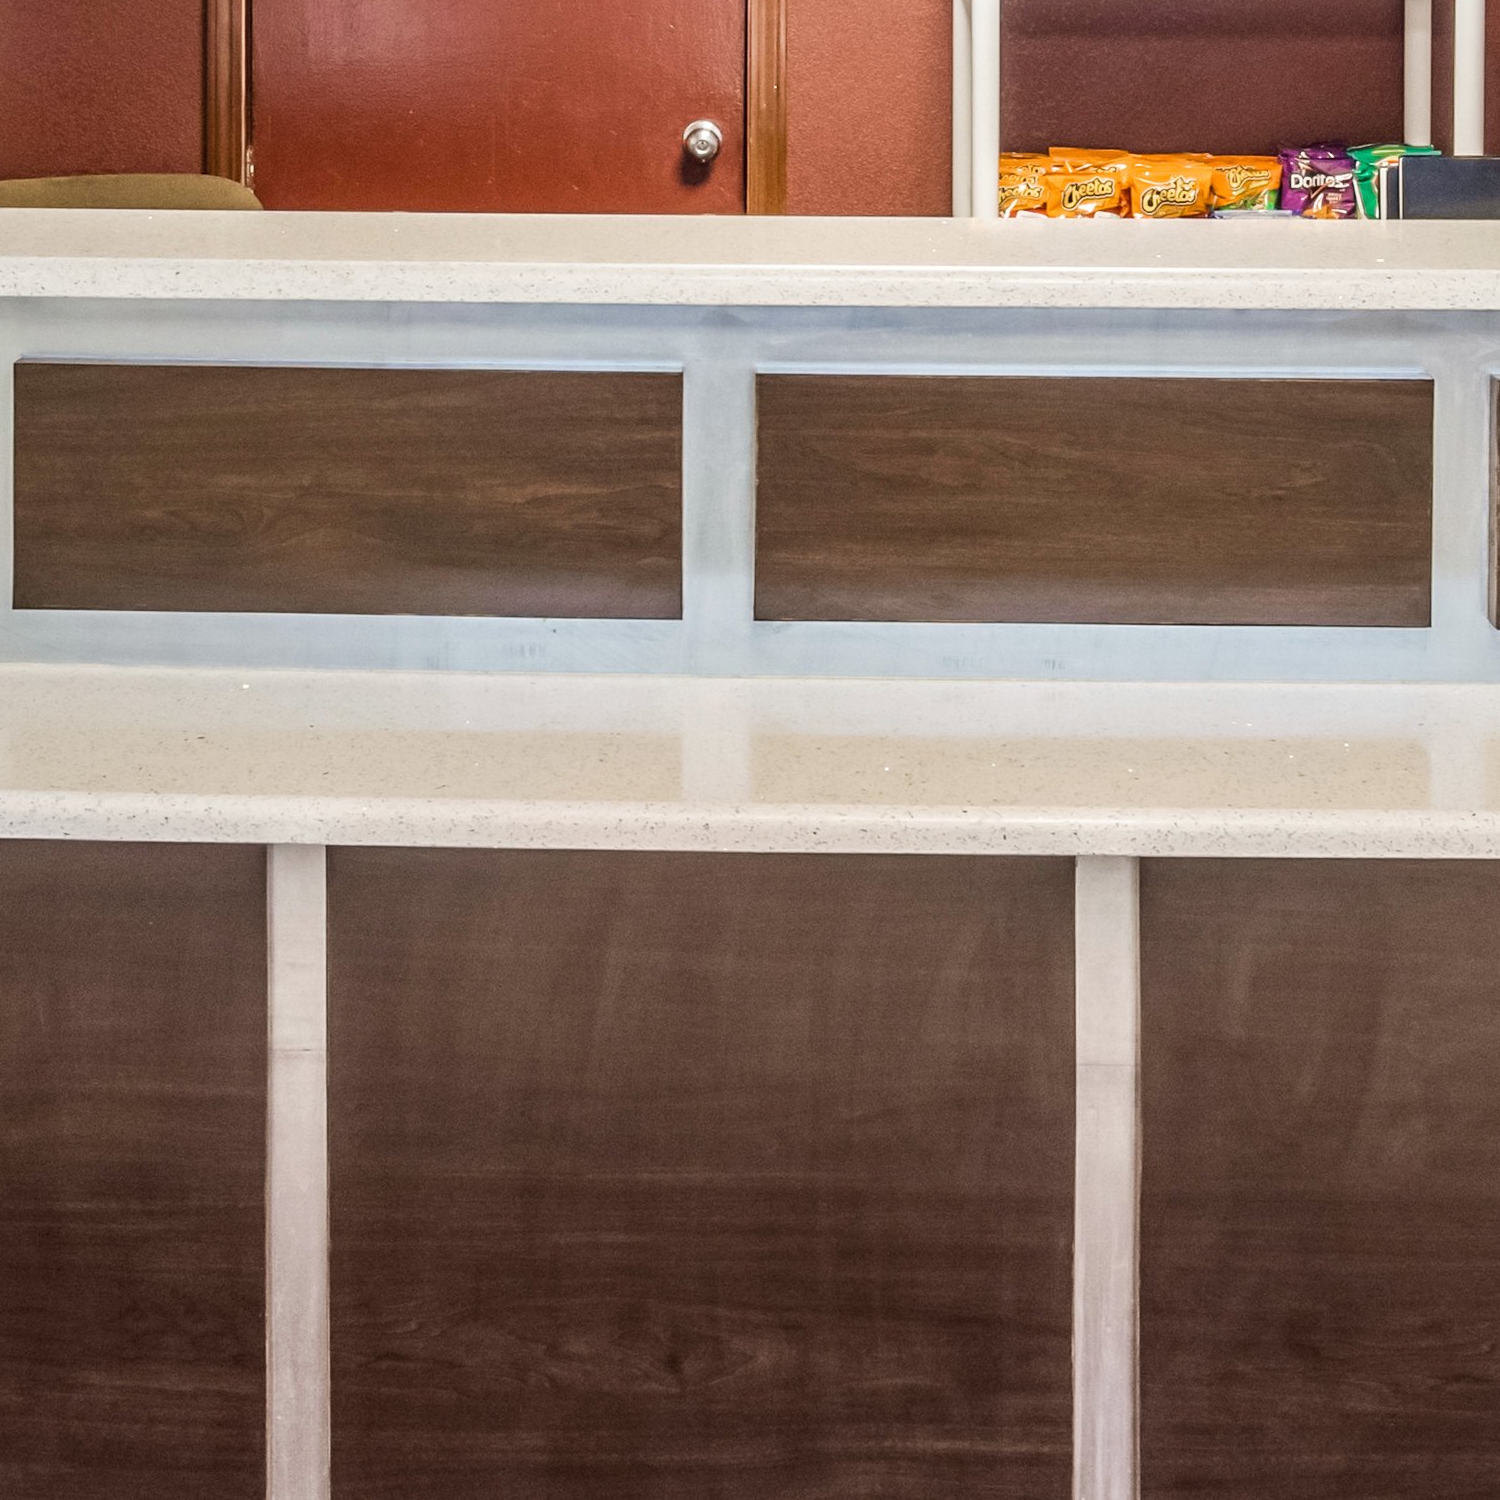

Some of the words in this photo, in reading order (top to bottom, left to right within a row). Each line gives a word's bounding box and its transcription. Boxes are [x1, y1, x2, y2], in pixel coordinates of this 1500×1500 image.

[1063, 178, 1113, 209] Cheetos
[1142, 178, 1198, 214] Cheetos
[1290, 173, 1345, 189] Doritos
